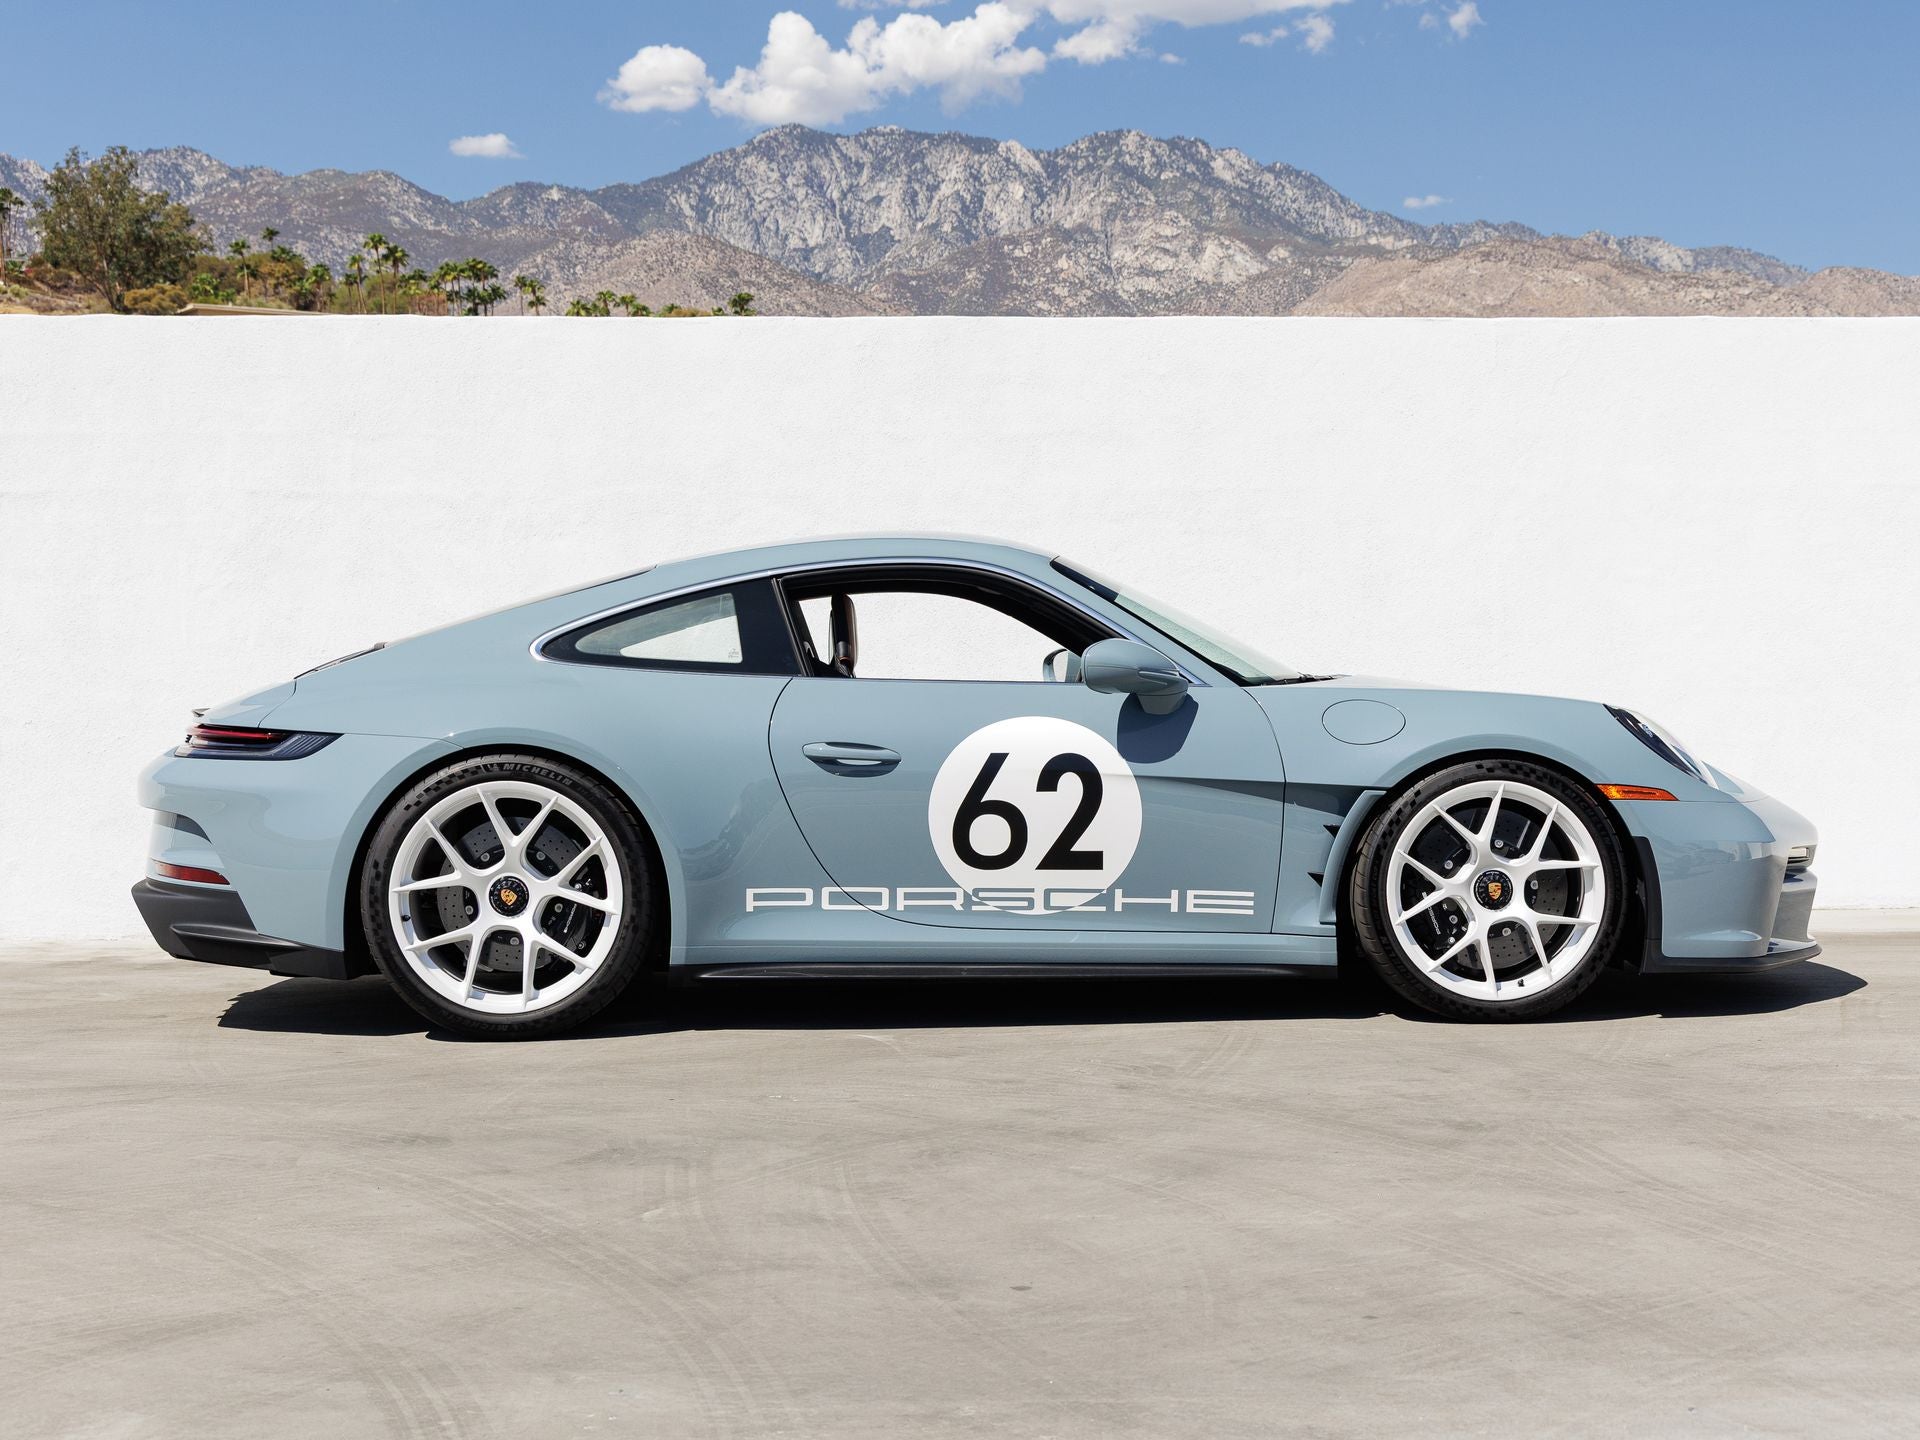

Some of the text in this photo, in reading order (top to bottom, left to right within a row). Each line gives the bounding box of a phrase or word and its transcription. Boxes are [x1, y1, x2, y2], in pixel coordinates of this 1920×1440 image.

[503, 763, 573, 786] MICHELIN
[952, 752, 1104, 871] 62
[745, 886, 1255, 915] PORSCHE
